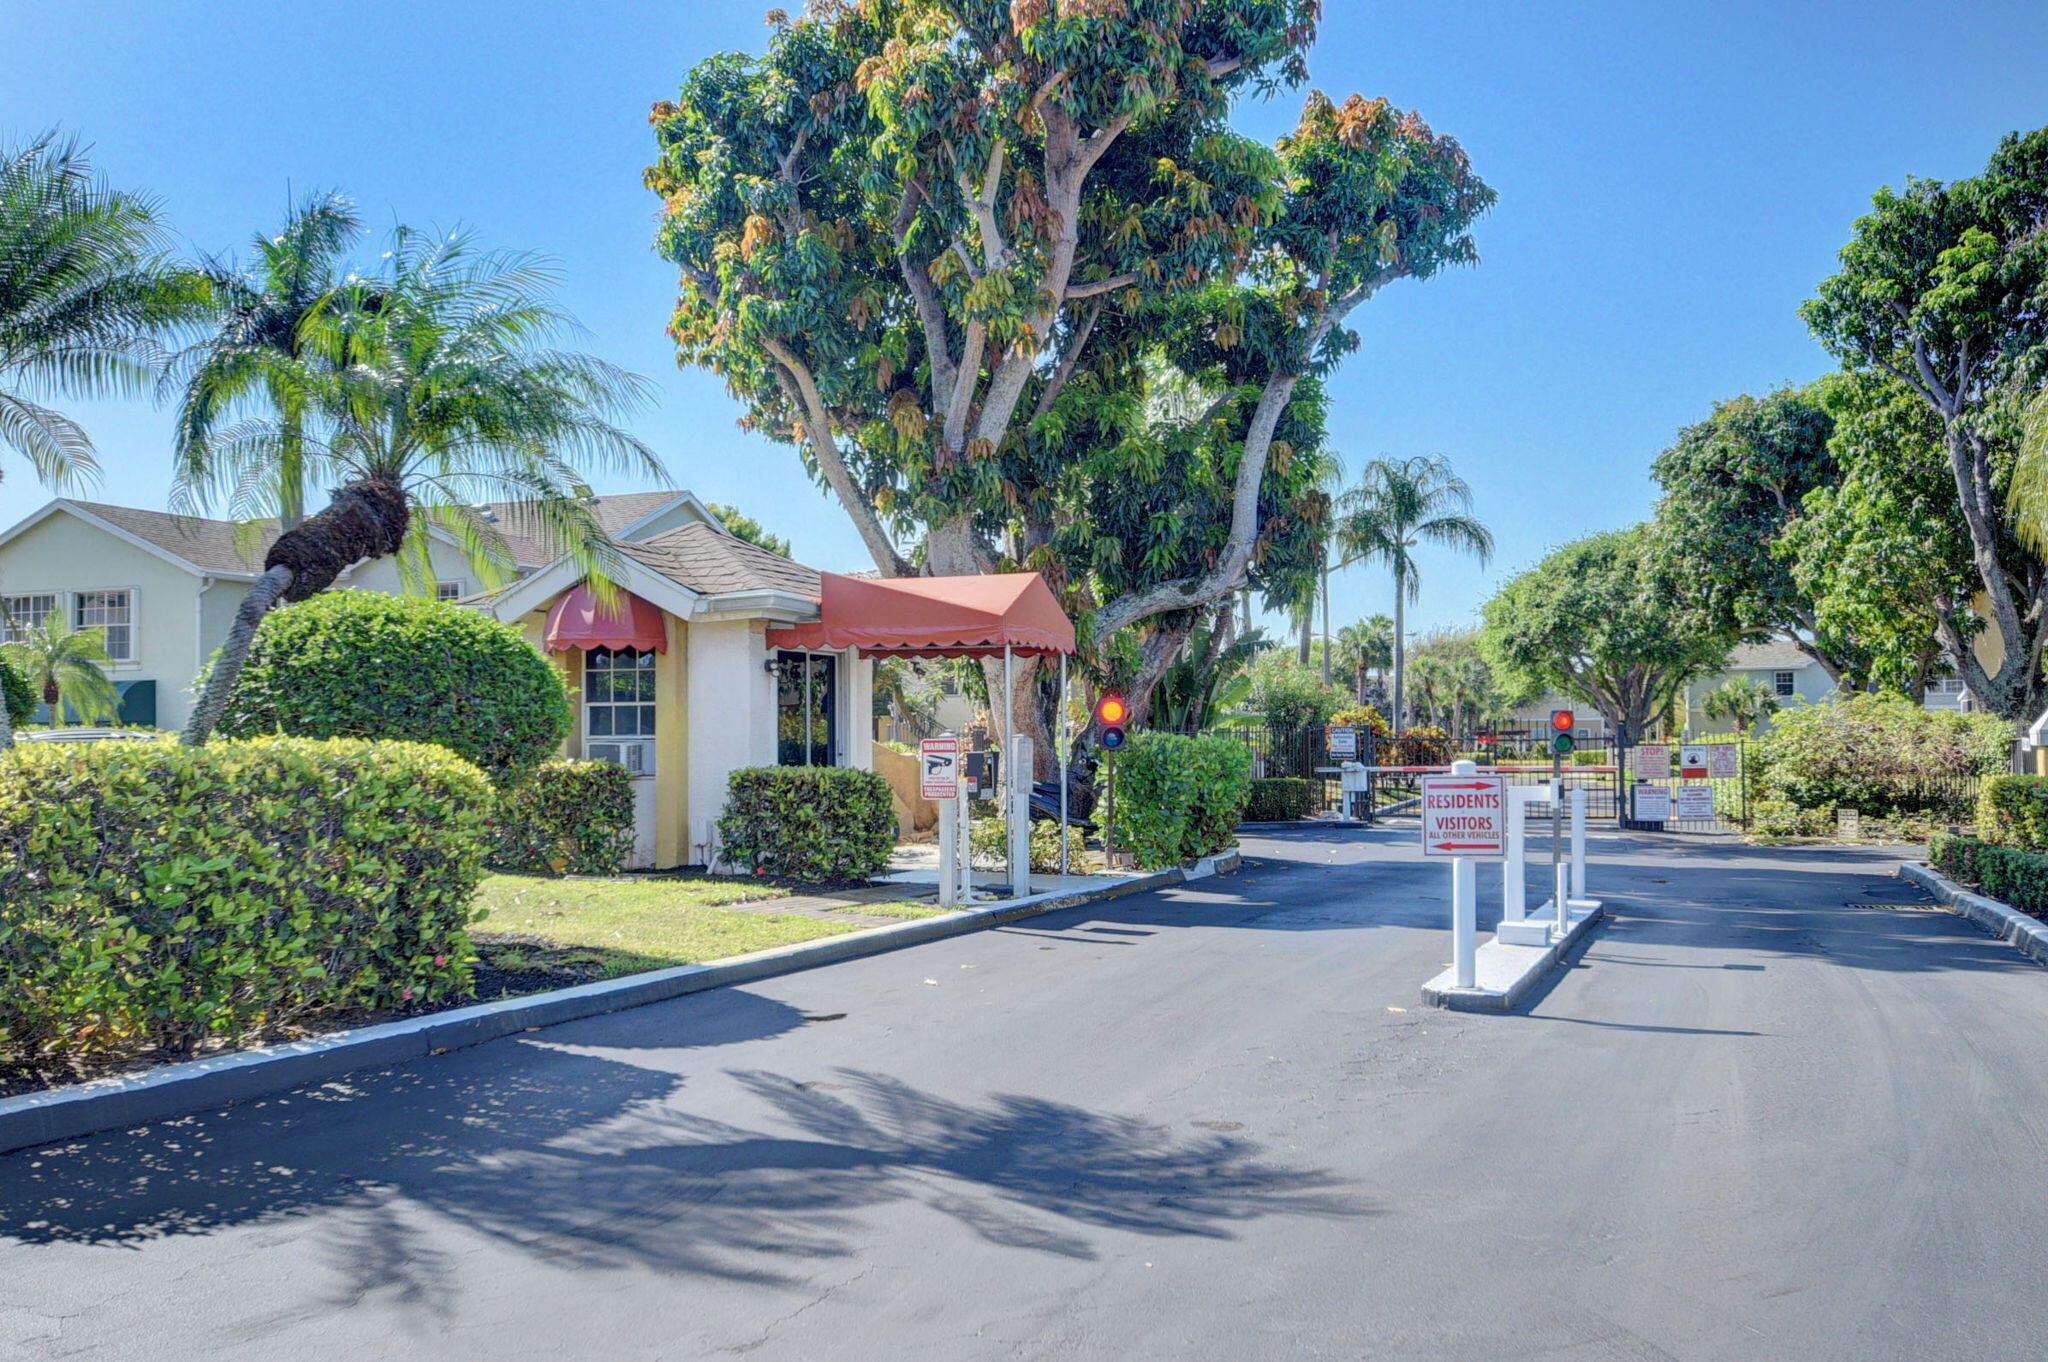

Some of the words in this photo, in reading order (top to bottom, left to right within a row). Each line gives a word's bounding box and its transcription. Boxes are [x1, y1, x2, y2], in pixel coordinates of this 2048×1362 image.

[924, 742, 956, 750] WARNING
[1428, 794, 1499, 809] RESIDENTS
[1435, 816, 1493, 830] VISITORS
[1429, 831, 1441, 839] ALL
[1443, 831, 1465, 839] OTHER
[1467, 831, 1499, 839] VEHICLES
